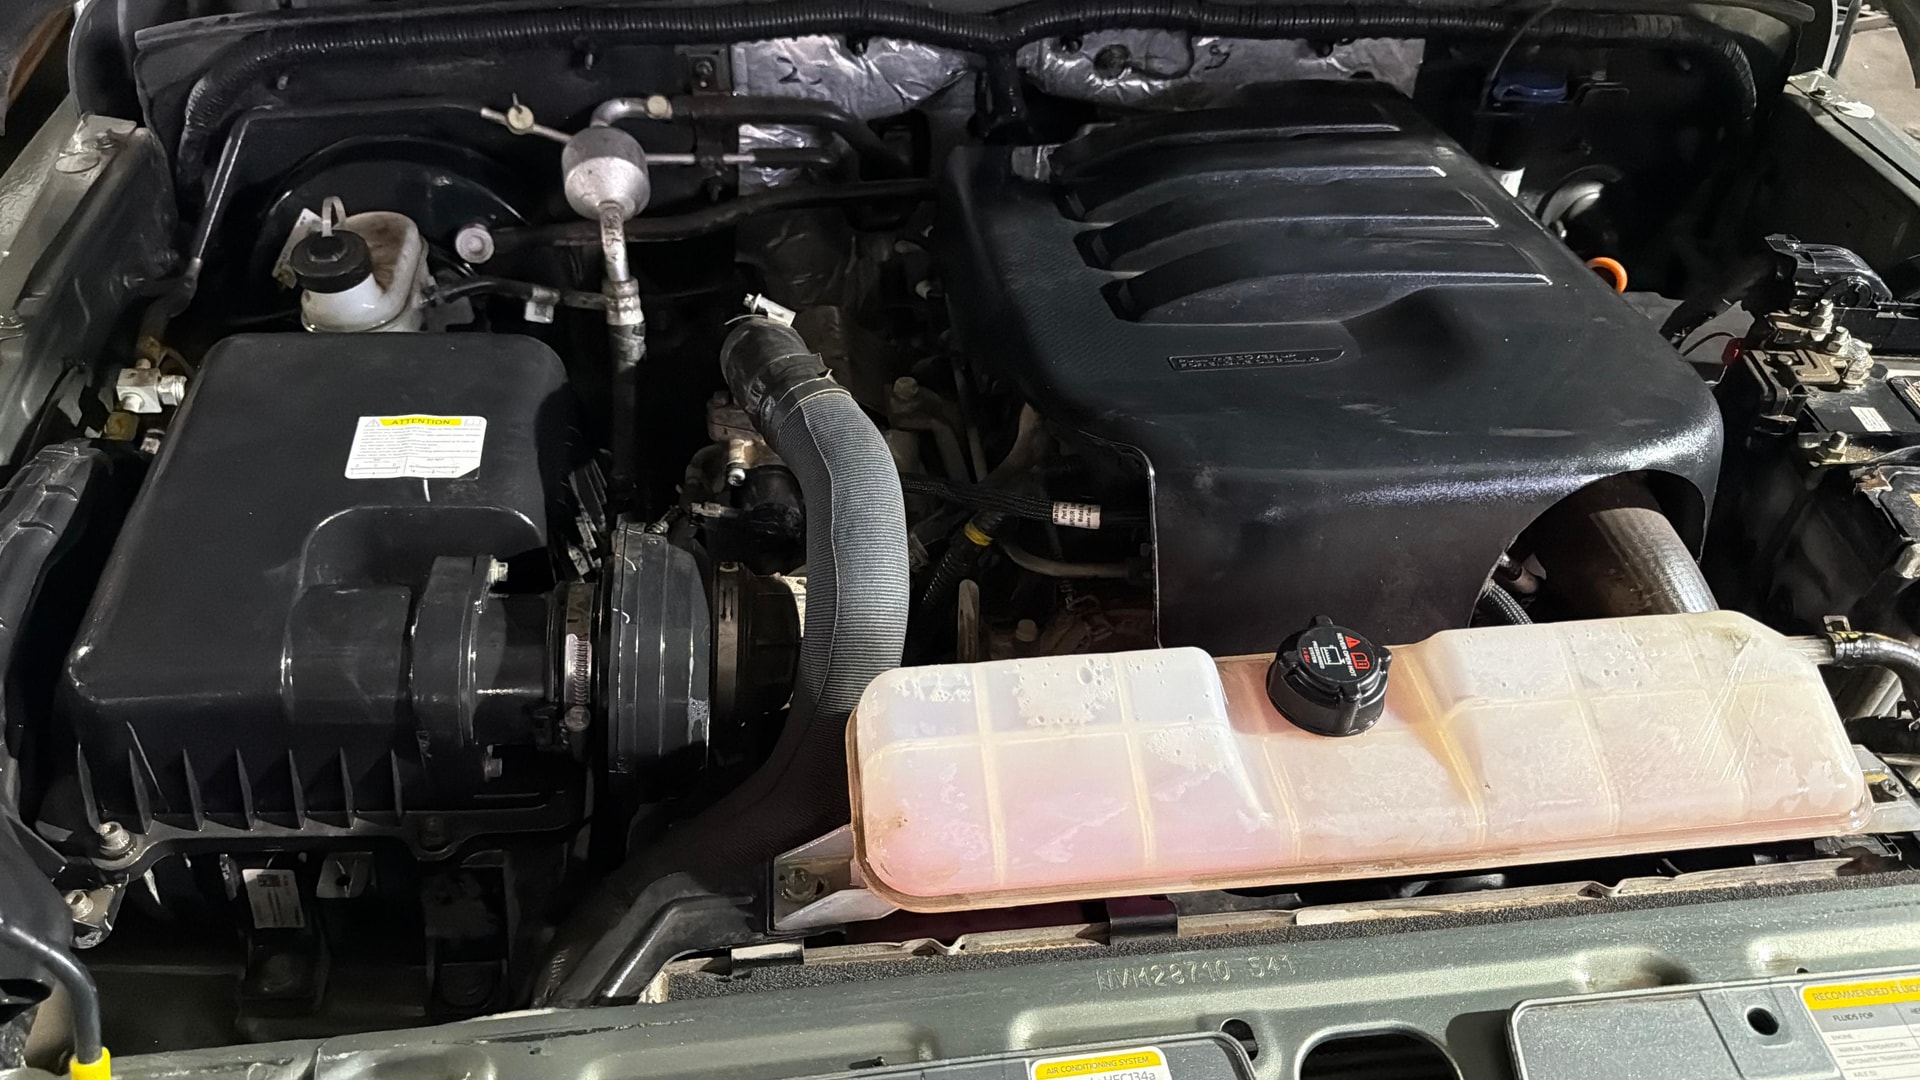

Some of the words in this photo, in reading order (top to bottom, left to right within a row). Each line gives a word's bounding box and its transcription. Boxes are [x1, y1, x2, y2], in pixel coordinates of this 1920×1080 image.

[391, 418, 451, 426] ATTENTION
[1336, 632, 1347, 650] NEVER
[1342, 650, 1353, 665] OPEN
[1347, 665, 1357, 677] HOT
[1813, 987, 1889, 1001] RECOMMENDED
[1890, 983, 1920, 994] FLUID
[1859, 1011, 1874, 1020] FOR
[1046, 1067, 1059, 1075] AIR
[1061, 1060, 1117, 1074] CONDITIONING
[1118, 1056, 1150, 1066] SYSTEM
